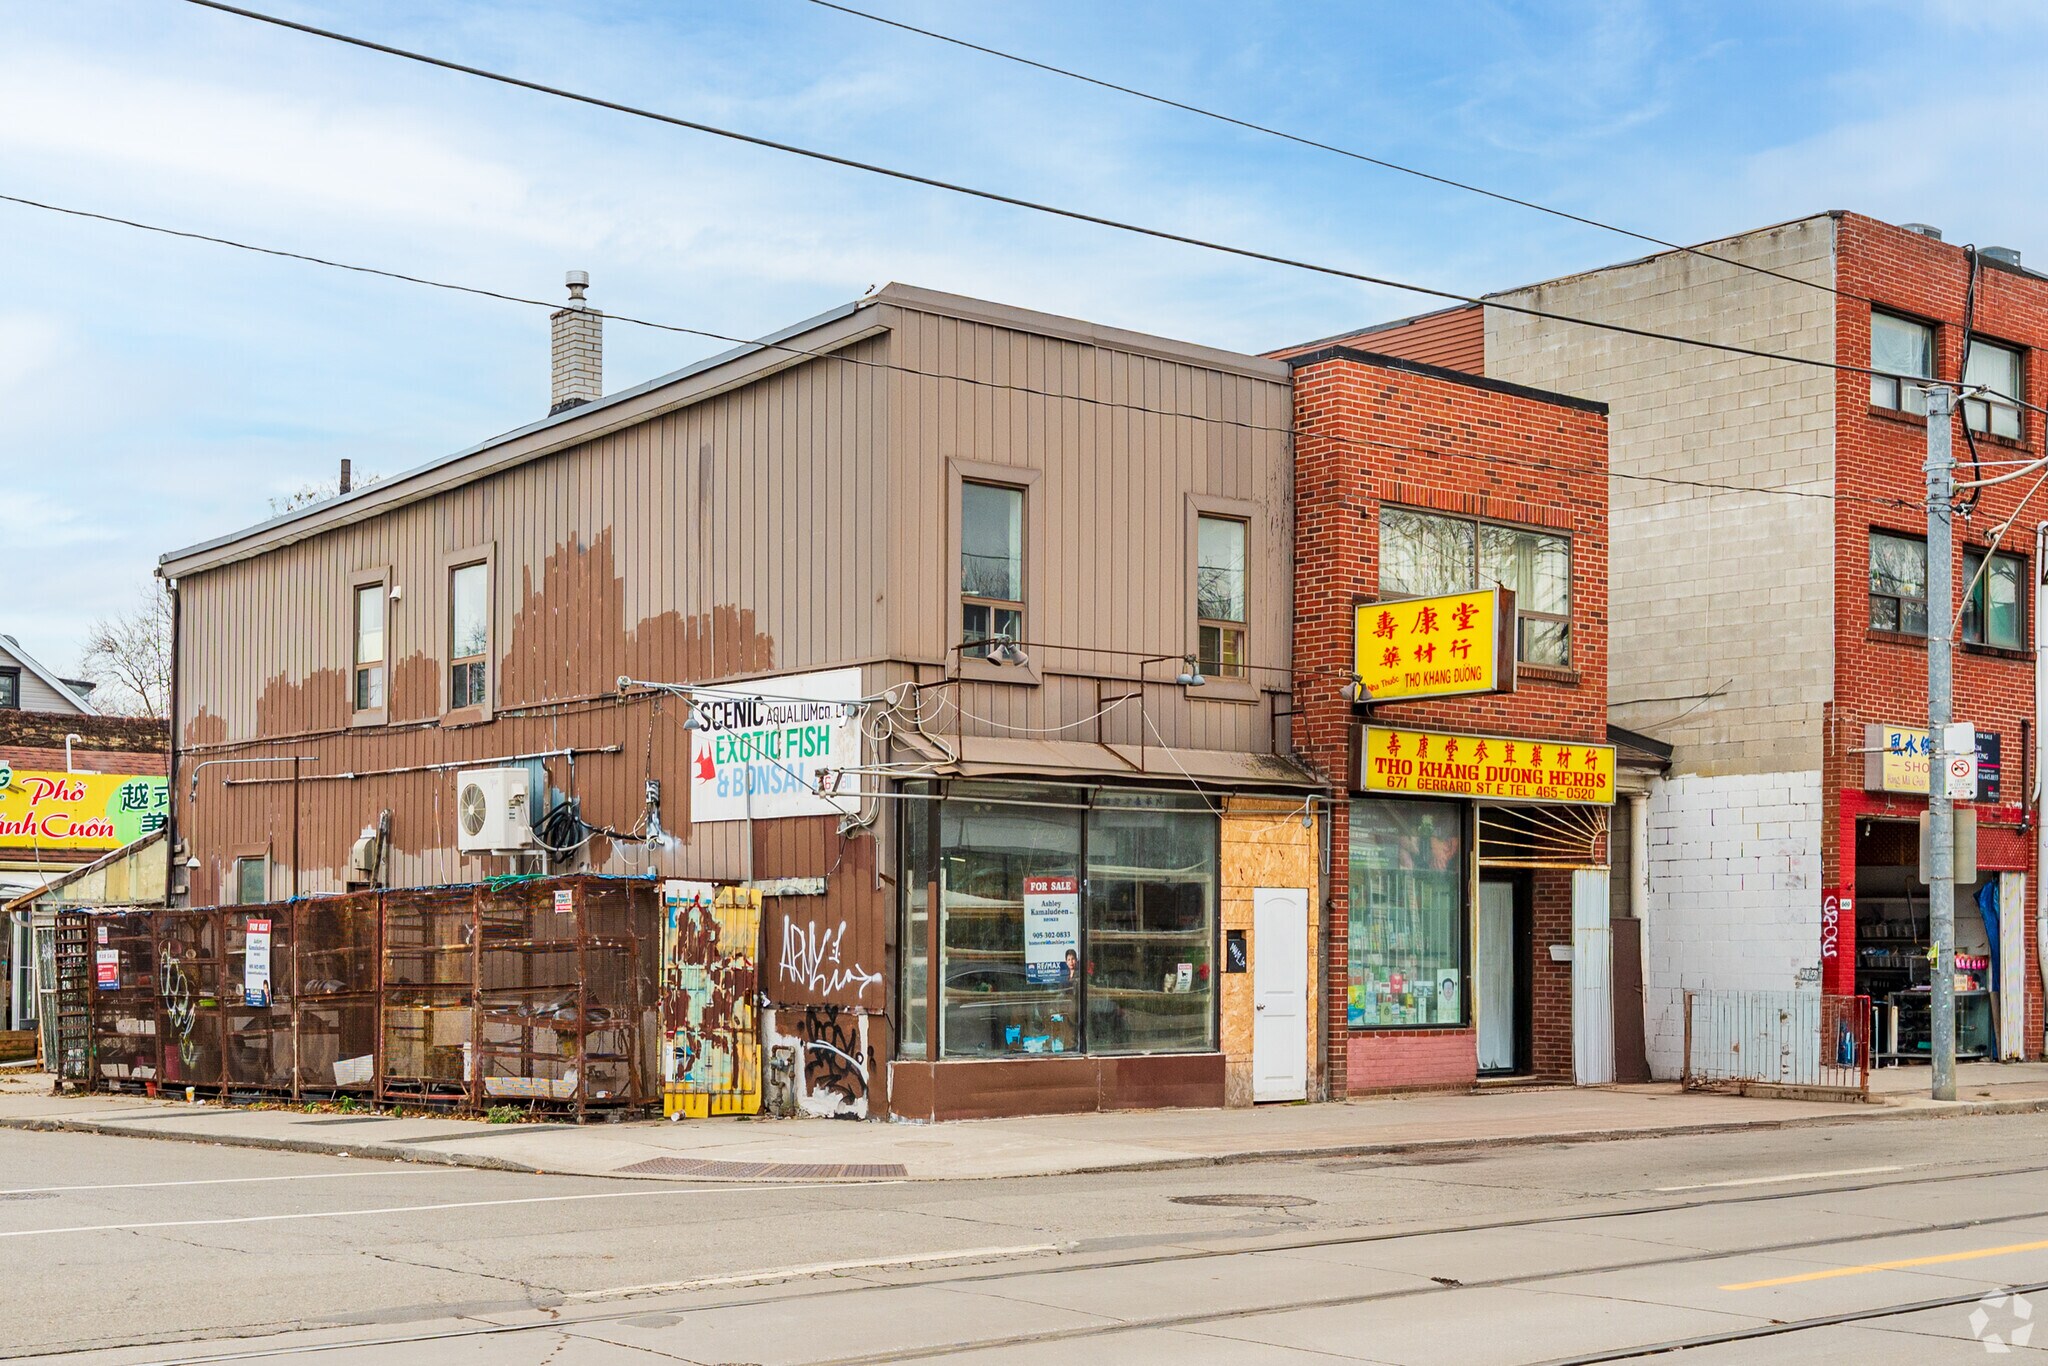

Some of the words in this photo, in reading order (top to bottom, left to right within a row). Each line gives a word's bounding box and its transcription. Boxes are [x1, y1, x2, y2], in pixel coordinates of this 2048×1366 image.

[1423, 669, 1451, 687] KHANG
[700, 696, 764, 733] SCENIC
[716, 731, 782, 765] EXOTIC
[786, 725, 830, 759] FISH
[717, 768, 731, 798] &
[732, 762, 805, 797] BONSAI
[1375, 757, 1413, 776] THO
[1418, 761, 1479, 781] KHANG
[1486, 766, 1543, 785] DUONG
[1549, 770, 1606, 788] HERBS
[1387, 776, 1408, 789] 671
[1417, 778, 1472, 793] GERRARD
[22, 777, 87, 806] Phở
[41, 814, 114, 838] Cuốn
[1030, 882, 1048, 891] FOR
[1051, 881, 1072, 891] SALE
